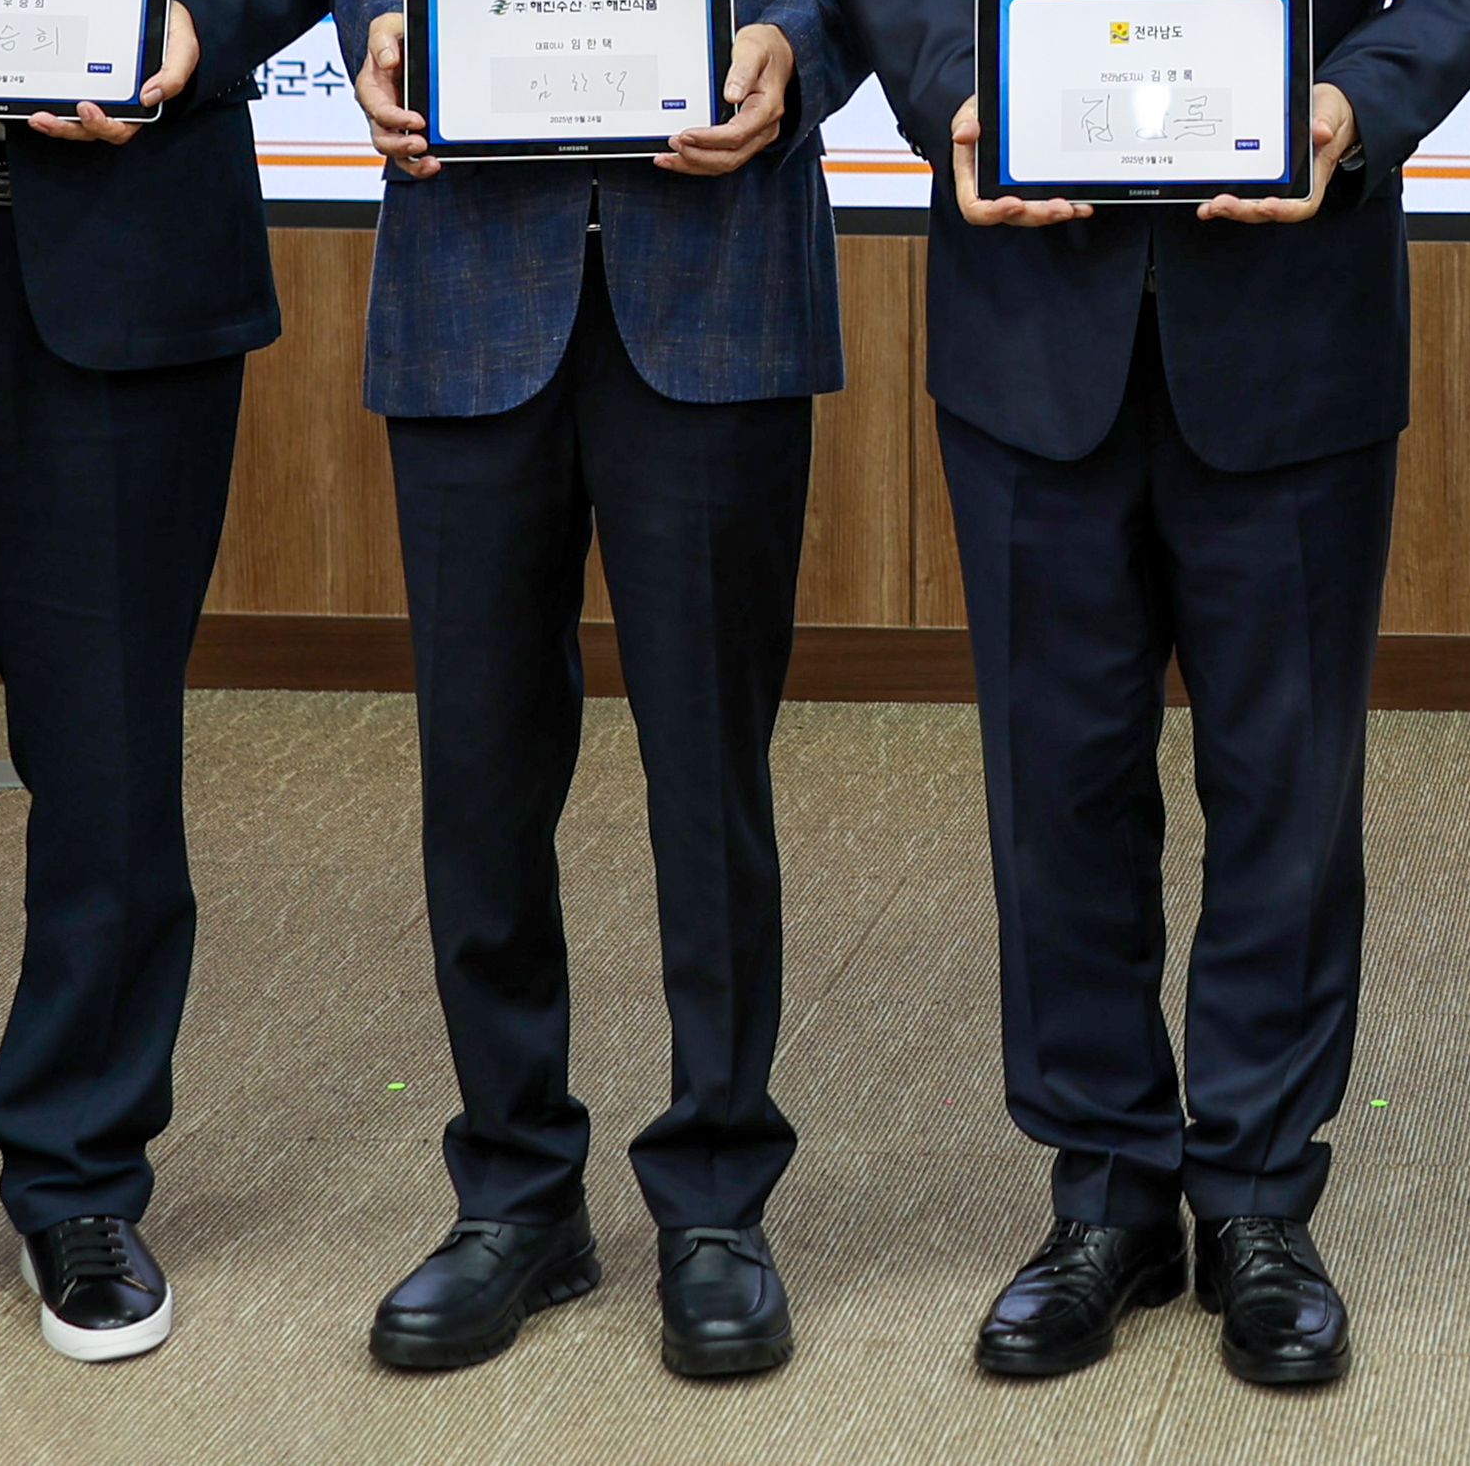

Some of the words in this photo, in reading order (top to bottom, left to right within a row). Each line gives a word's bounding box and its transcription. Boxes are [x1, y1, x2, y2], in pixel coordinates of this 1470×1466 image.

[606, 0, 657, 12] 해진식품
[1134, 25, 1183, 40] 전라남도
[535, 41, 565, 51] 대표이사
[9, 75, 25, 84] 24일
[549, 115, 573, 124] 2025년
[574, 115, 586, 124] 9월
[587, 115, 602, 124] 24일
[1120, 155, 1144, 165] 2025년
[1145, 156, 1157, 165] 9월
[1158, 156, 1173, 165] 24일
